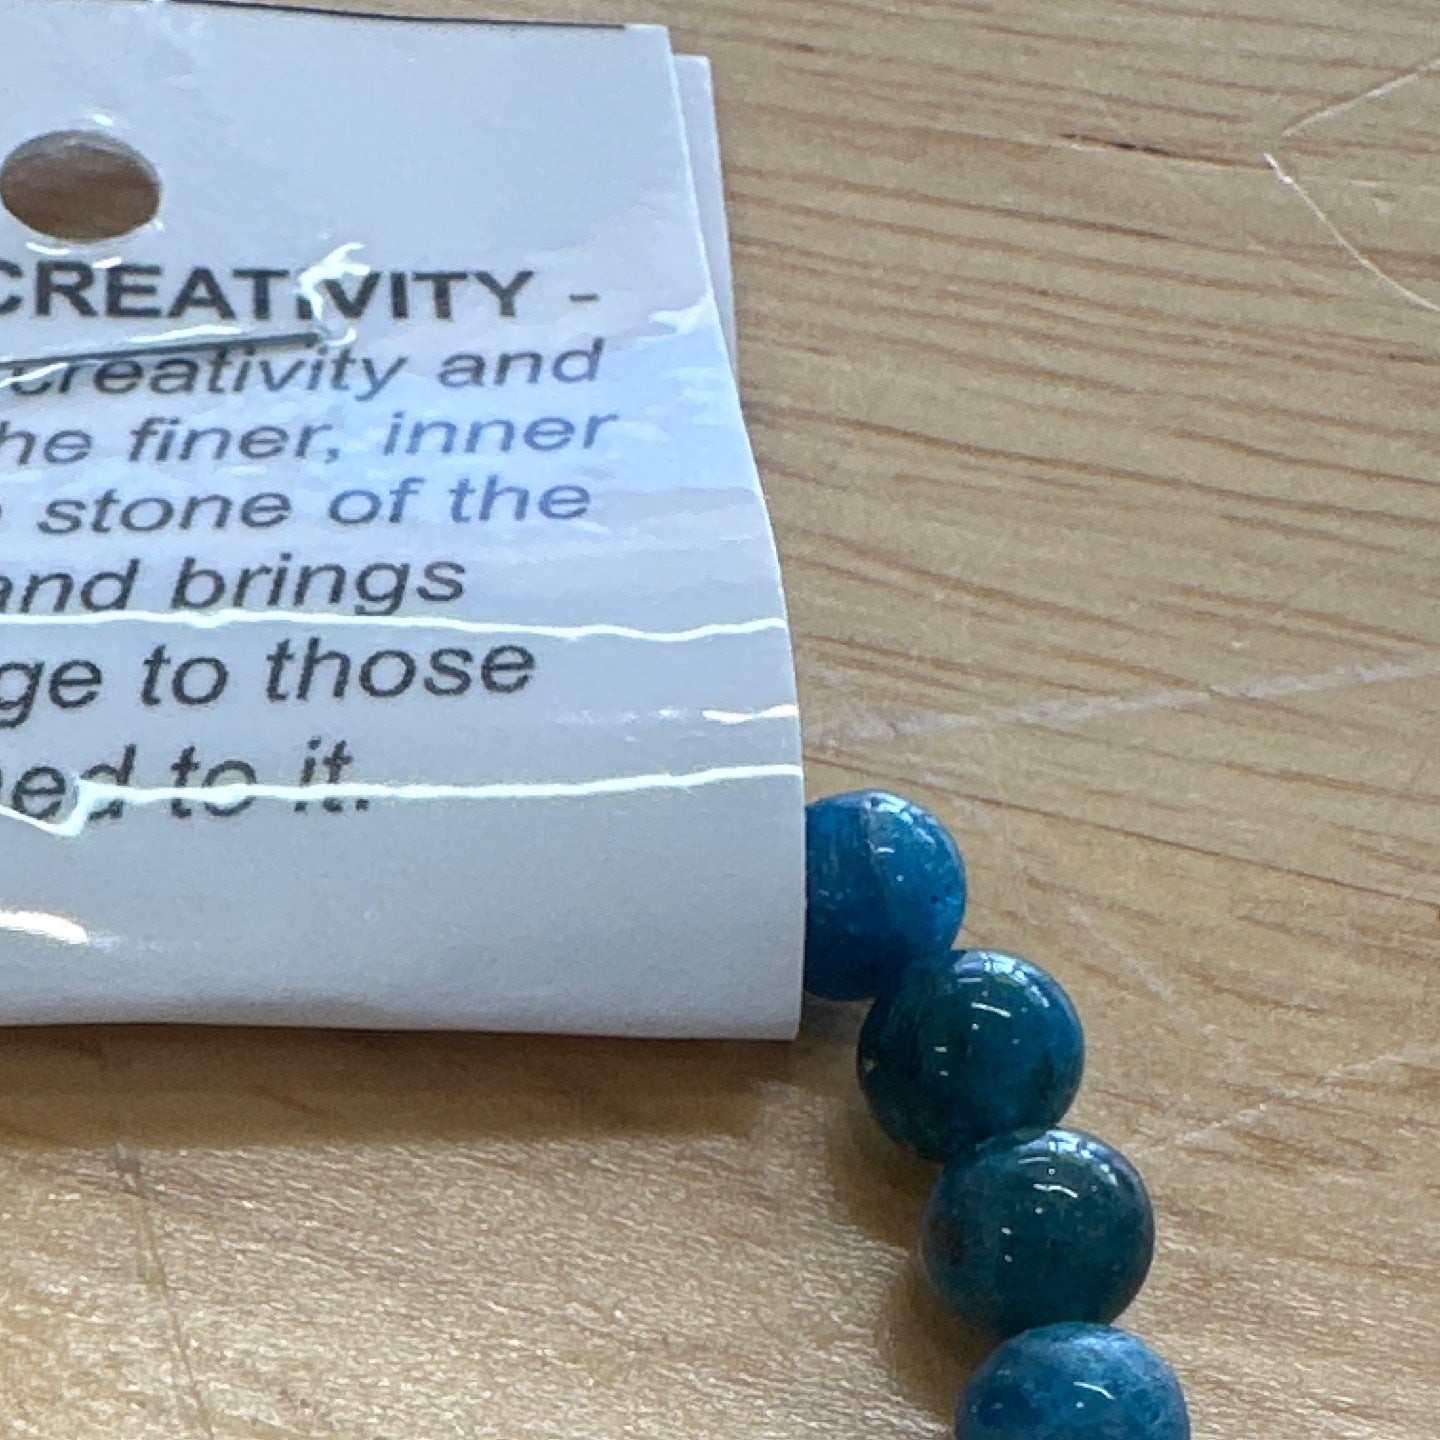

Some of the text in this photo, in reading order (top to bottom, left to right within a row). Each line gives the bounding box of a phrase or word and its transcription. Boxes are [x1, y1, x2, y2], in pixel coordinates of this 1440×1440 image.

[12, 342, 406, 400] creativity
[438, 337, 604, 387] and
[128, 416, 340, 464] finer,
[383, 411, 619, 456] inner
[36, 488, 292, 535] stone
[328, 477, 426, 525] of
[448, 475, 592, 522] the
[169, 552, 466, 617] brings
[140, 643, 229, 706] to
[265, 637, 536, 701] those
[169, 745, 258, 818] to
[292, 735, 371, 814] it.
